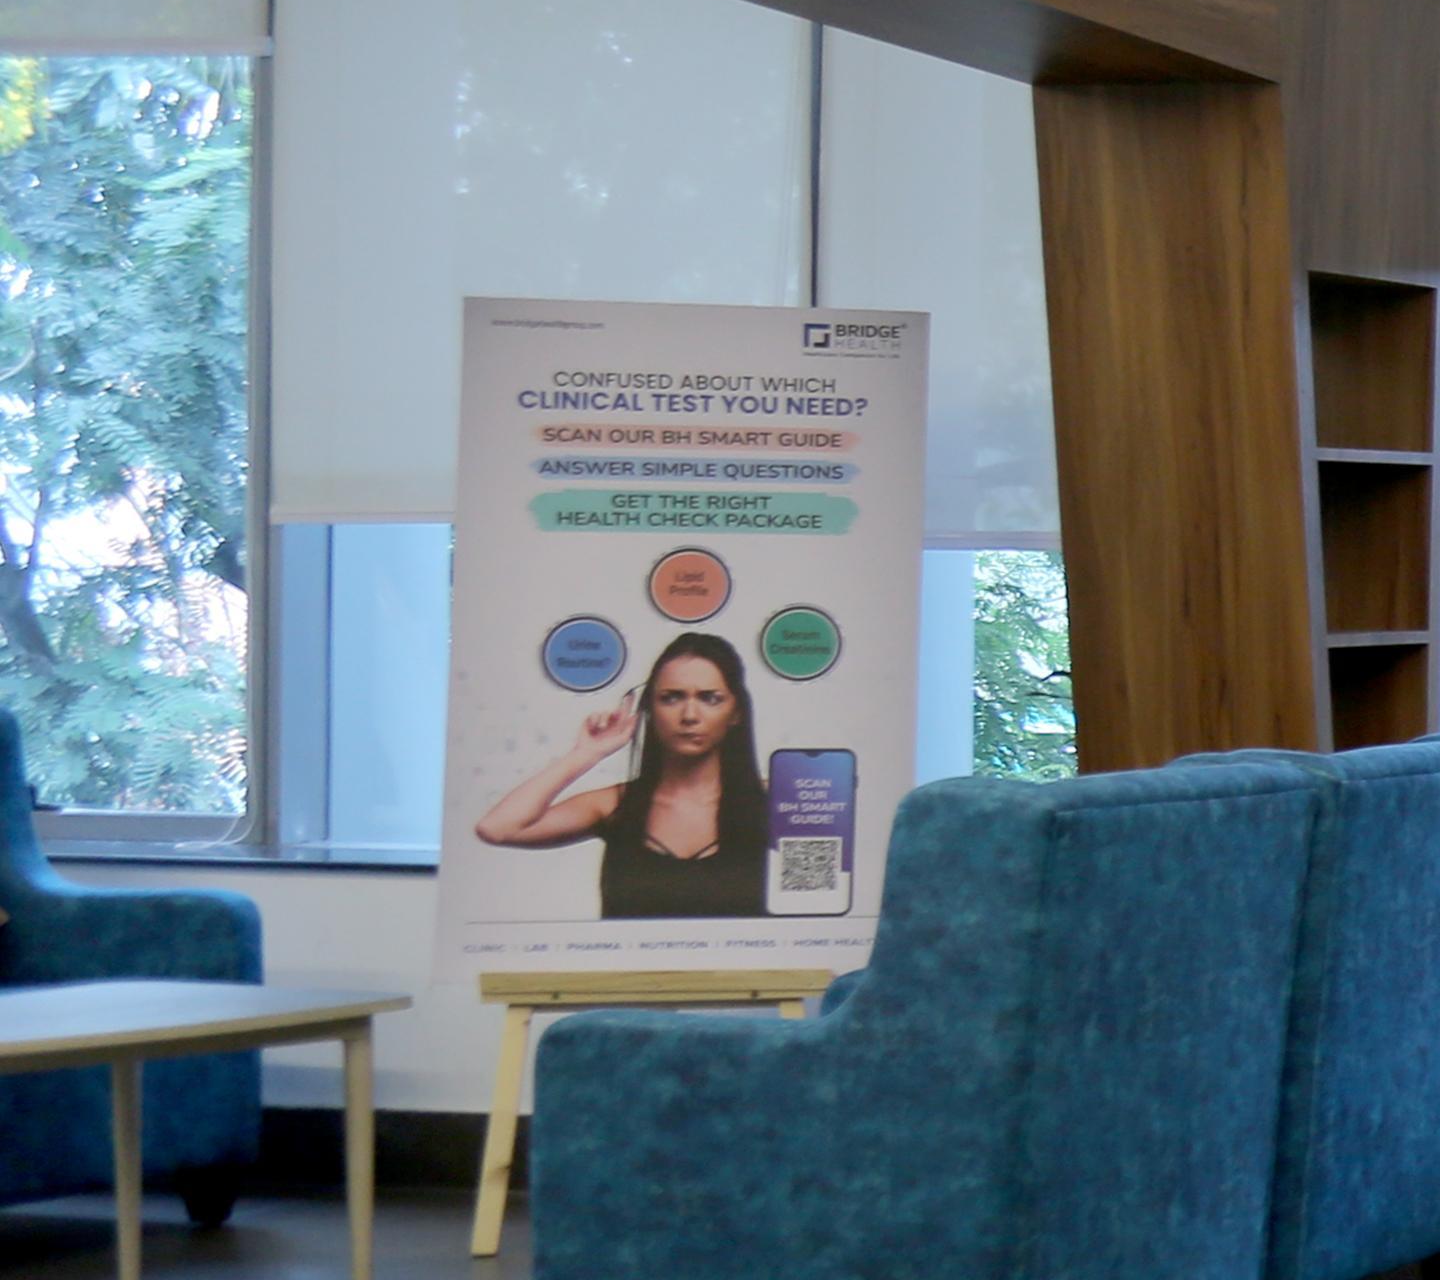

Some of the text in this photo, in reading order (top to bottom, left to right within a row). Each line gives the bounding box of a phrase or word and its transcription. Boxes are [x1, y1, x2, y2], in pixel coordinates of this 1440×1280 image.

[836, 324, 900, 338] BRIDGE
[553, 371, 836, 393] CONFUSED ABOUT WHICH
[517, 390, 868, 416] CLINICAL TEST YOU NEED?
[543, 427, 842, 448] SCAN OUR BH SMART GUIDE
[538, 460, 844, 480] ANSWER SIMPLE QUESTIONS
[611, 494, 772, 510] GET THE RIGHT
[557, 511, 823, 529] HEALTH CHECK PACKAGE
